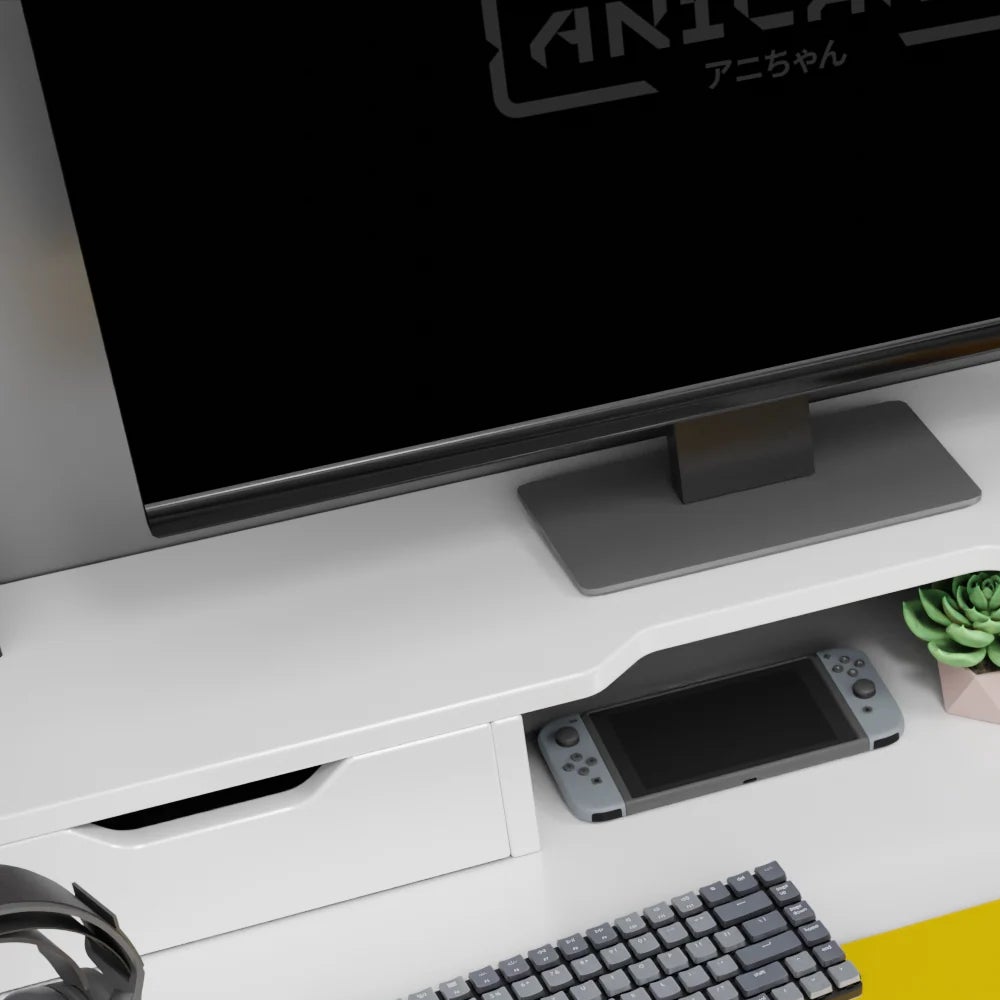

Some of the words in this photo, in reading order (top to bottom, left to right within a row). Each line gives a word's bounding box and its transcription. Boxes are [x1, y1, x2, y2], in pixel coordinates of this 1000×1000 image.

[704, 39, 848, 89] アニちゃん
